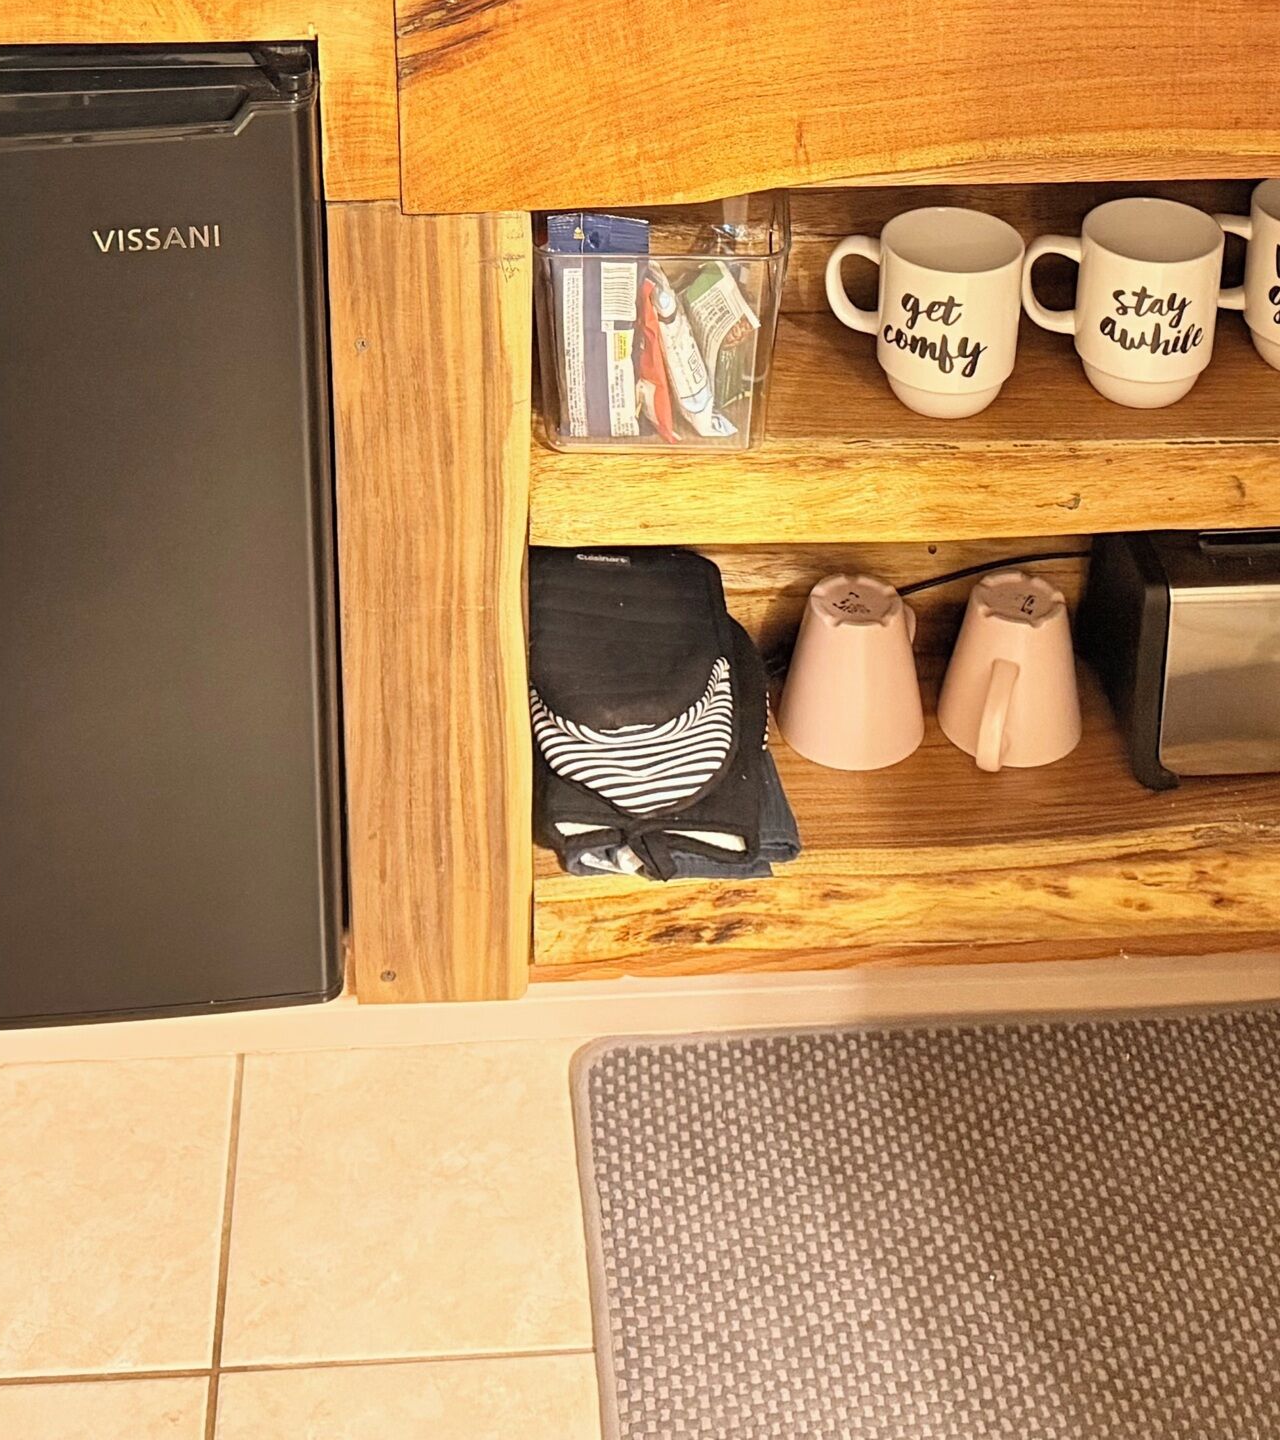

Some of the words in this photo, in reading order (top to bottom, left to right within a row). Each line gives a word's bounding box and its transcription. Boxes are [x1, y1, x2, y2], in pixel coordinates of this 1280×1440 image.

[92, 224, 221, 253] VISSANI
[900, 292, 964, 329] get
[1112, 285, 1192, 329] stay
[883, 323, 988, 378] comfy
[1099, 315, 1205, 356] awhile
[576, 553, 628, 564] Cuisinart
